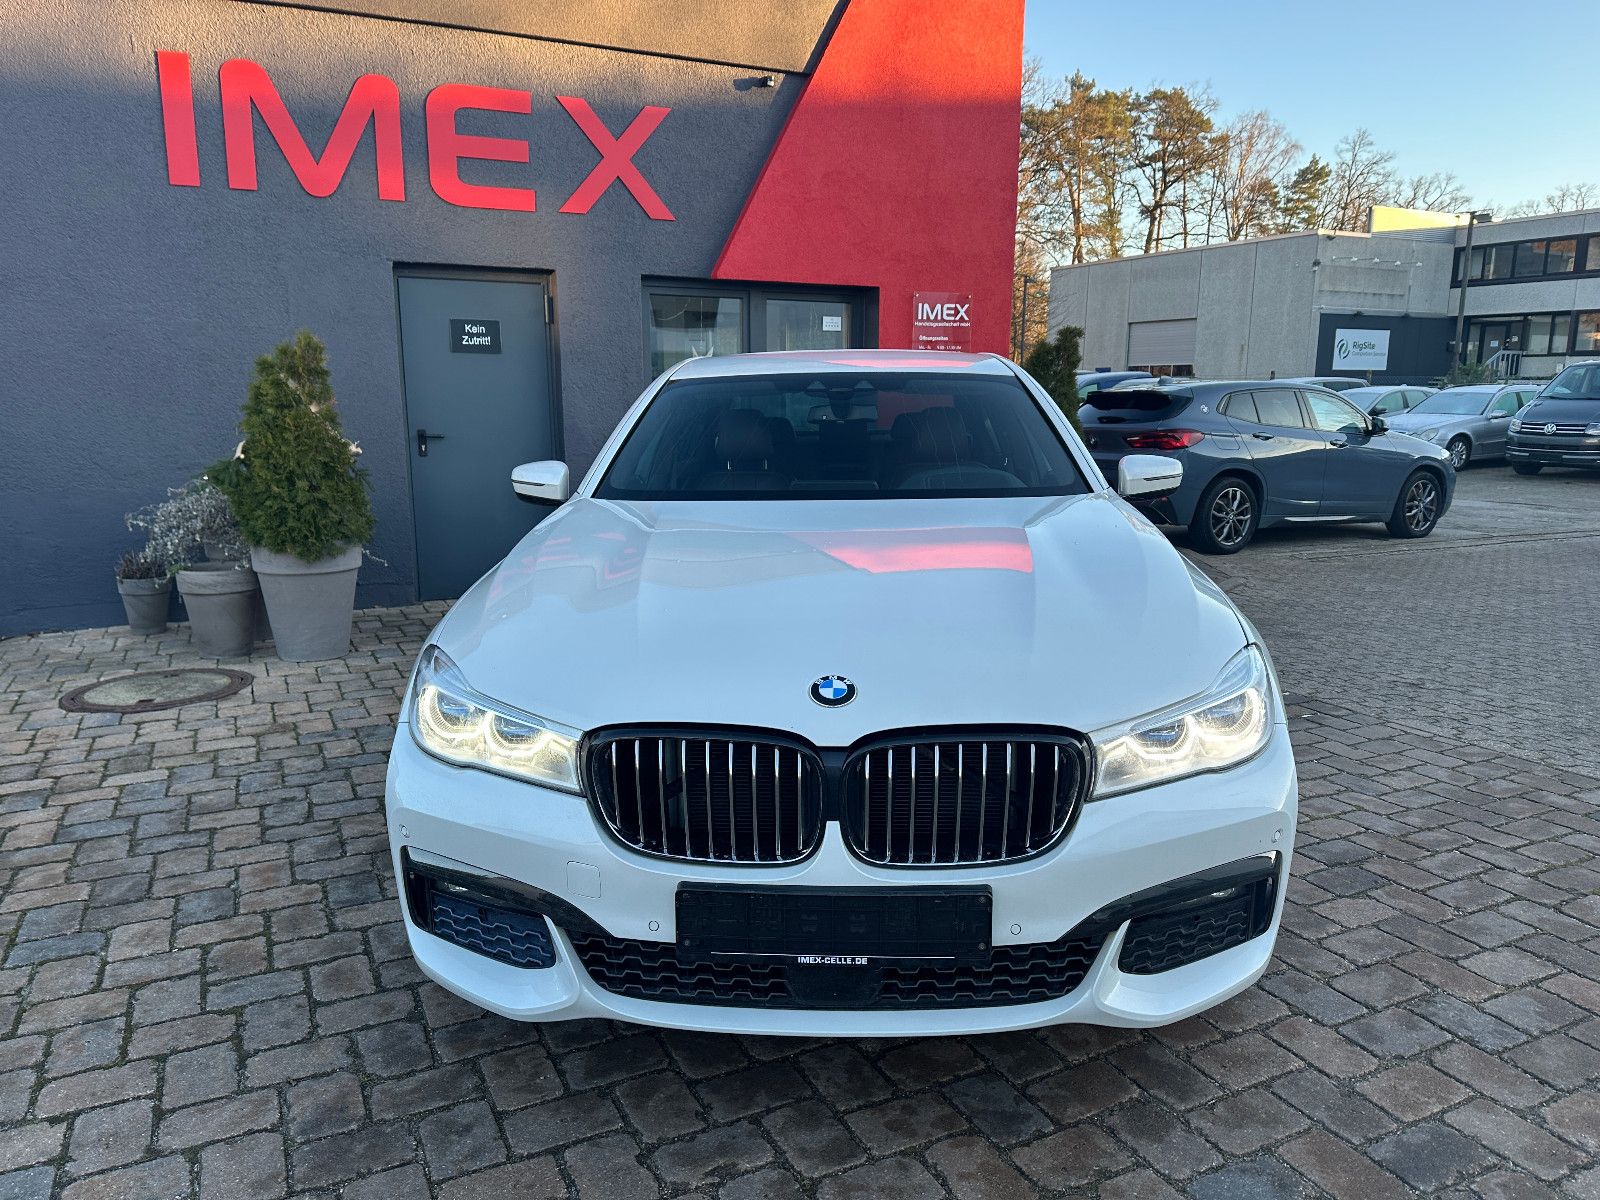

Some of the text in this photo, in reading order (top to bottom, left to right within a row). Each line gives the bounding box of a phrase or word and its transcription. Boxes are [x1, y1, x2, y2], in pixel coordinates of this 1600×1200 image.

[156, 50, 676, 221] IMEX
[917, 303, 970, 320] IMEX
[464, 324, 486, 334] Kein
[462, 335, 491, 345] Zutritt!
[1352, 341, 1376, 351] RigSite
[797, 956, 868, 965] IMEX-CELLE.DE
